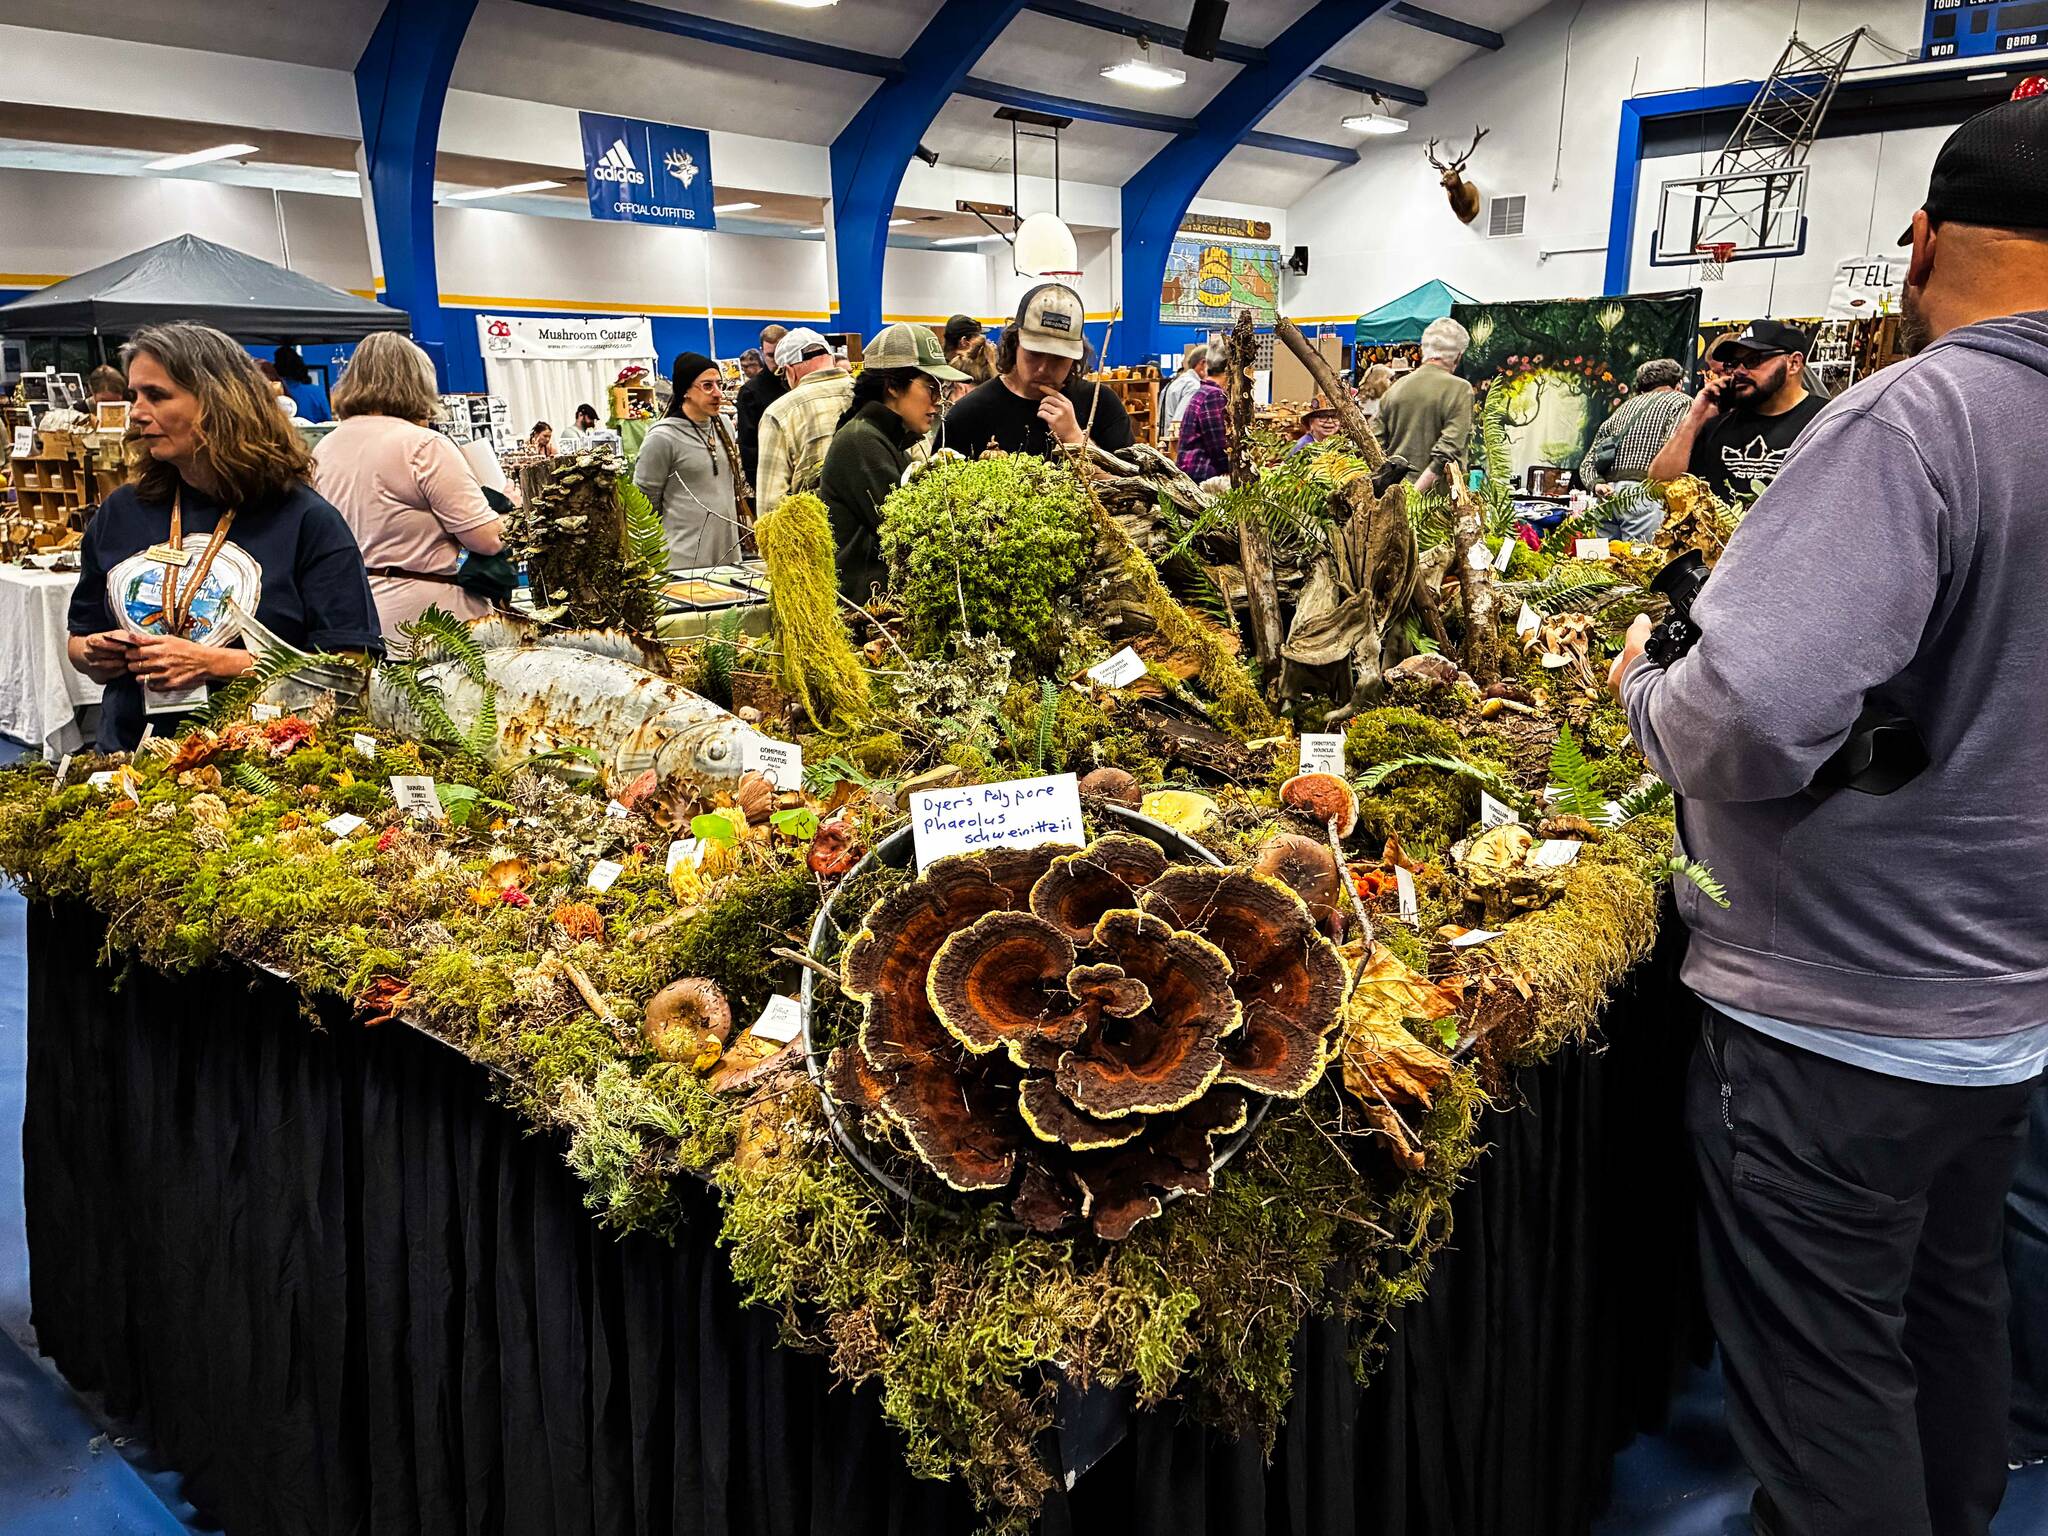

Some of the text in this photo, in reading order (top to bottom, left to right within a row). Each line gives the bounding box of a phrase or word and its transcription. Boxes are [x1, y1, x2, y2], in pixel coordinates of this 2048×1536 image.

[1931, 43, 1954, 57] won
[2005, 34, 2038, 50] game
[593, 165, 645, 185] adidas
[613, 201, 696, 220] OFFICIAL OUTFITTER
[1842, 264, 1893, 287] TELL
[538, 328, 638, 342] Mushroom Cottage
[923, 791, 973, 817] Dyer's
